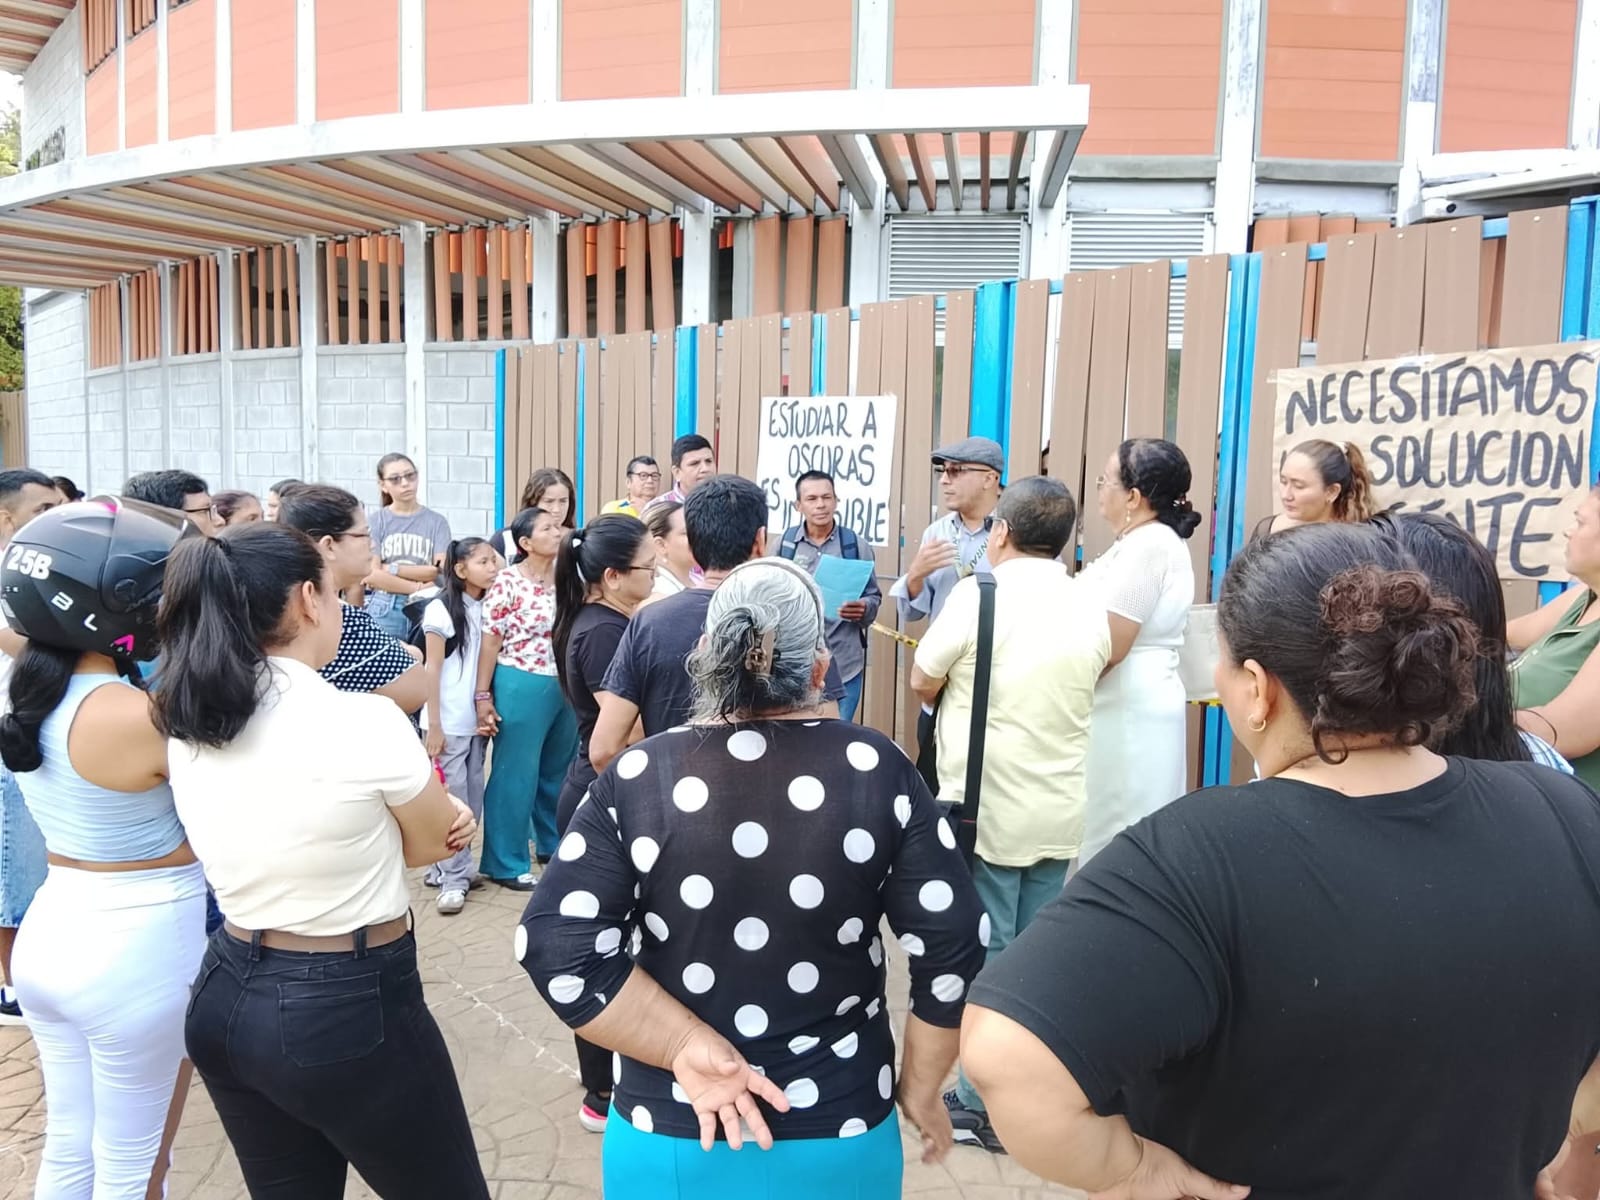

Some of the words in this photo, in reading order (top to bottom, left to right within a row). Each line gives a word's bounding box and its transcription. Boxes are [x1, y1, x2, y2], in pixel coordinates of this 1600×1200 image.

[1285, 352, 1595, 434] NECESITAMOS
[769, 400, 852, 438] ESTUDIAR
[862, 401, 877, 438] A
[788, 443, 875, 486] OSCURAS
[1370, 428, 1584, 489] SOLUCION
[7, 545, 52, 580] 25B
